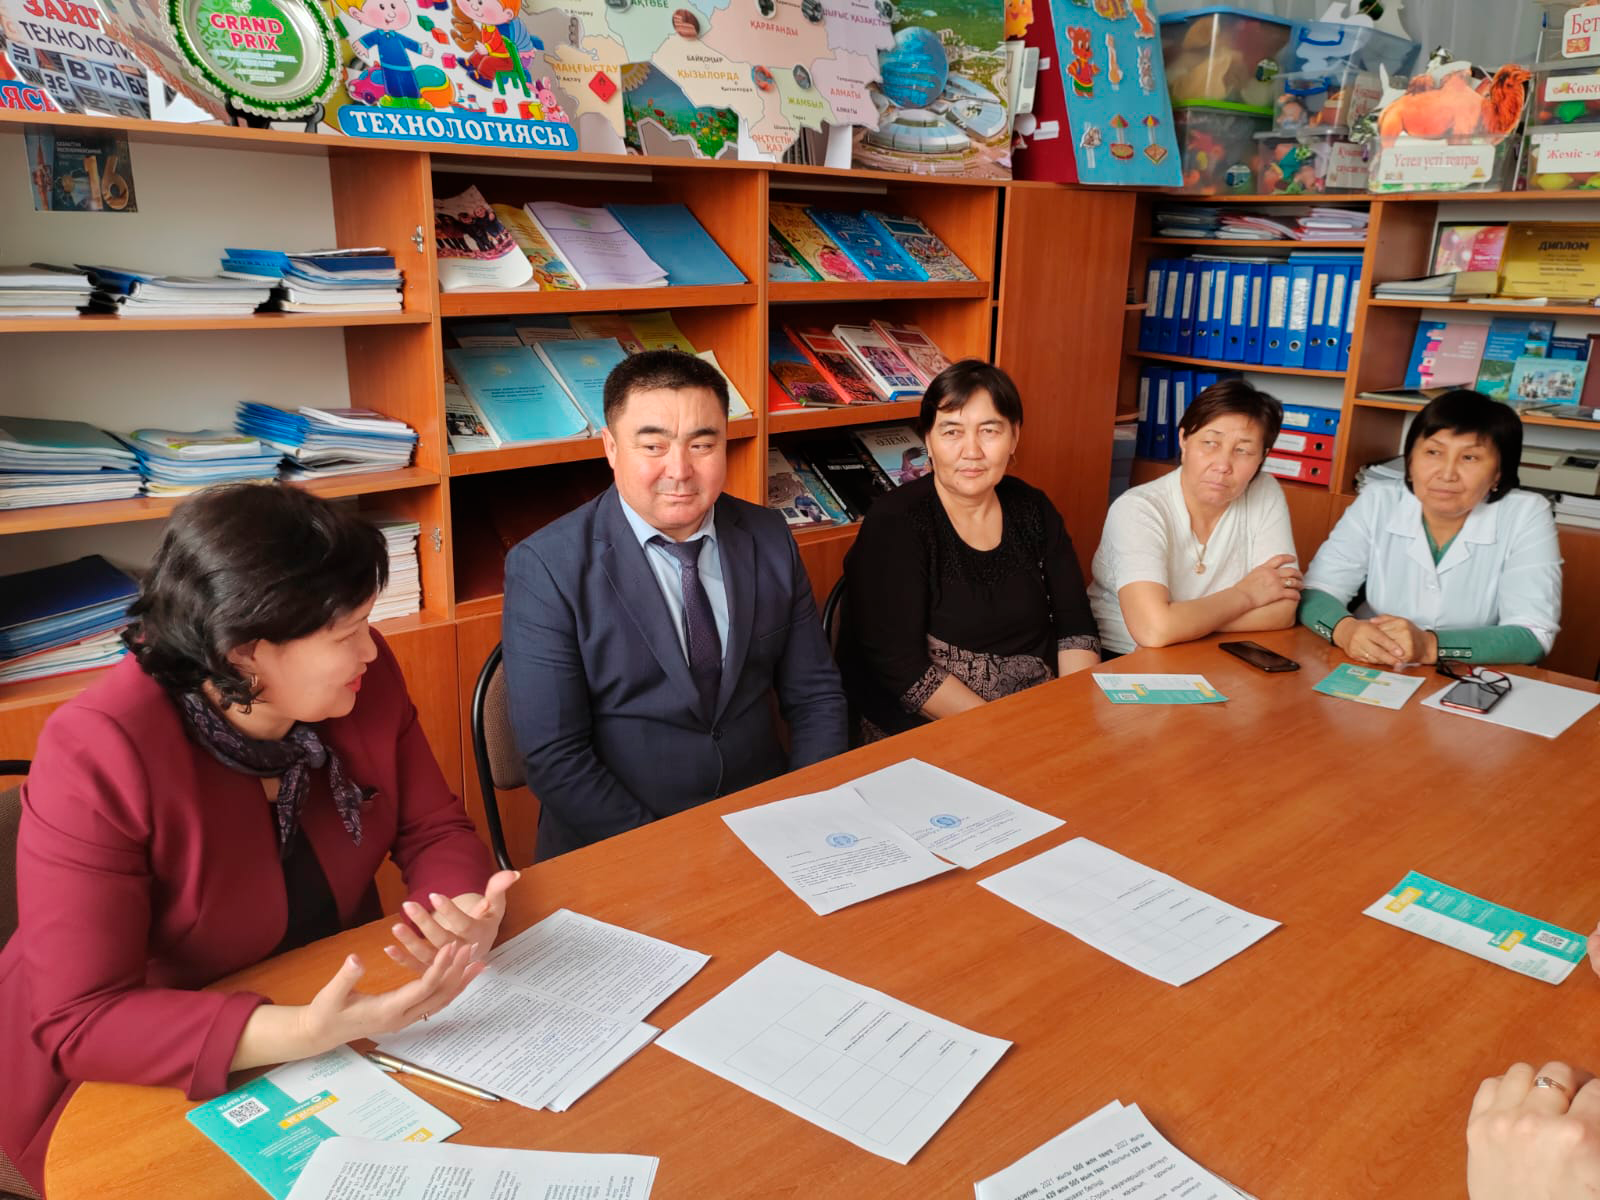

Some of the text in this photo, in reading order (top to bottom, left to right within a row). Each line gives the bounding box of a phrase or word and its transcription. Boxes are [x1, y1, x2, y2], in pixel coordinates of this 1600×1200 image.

[210, 13, 284, 34] GRAND
[230, 31, 280, 52] PRIX
[349, 111, 570, 147] ТЕХНОЛОГИЯСЫ
[1538, 241, 1589, 251] ДИПЛОМ
